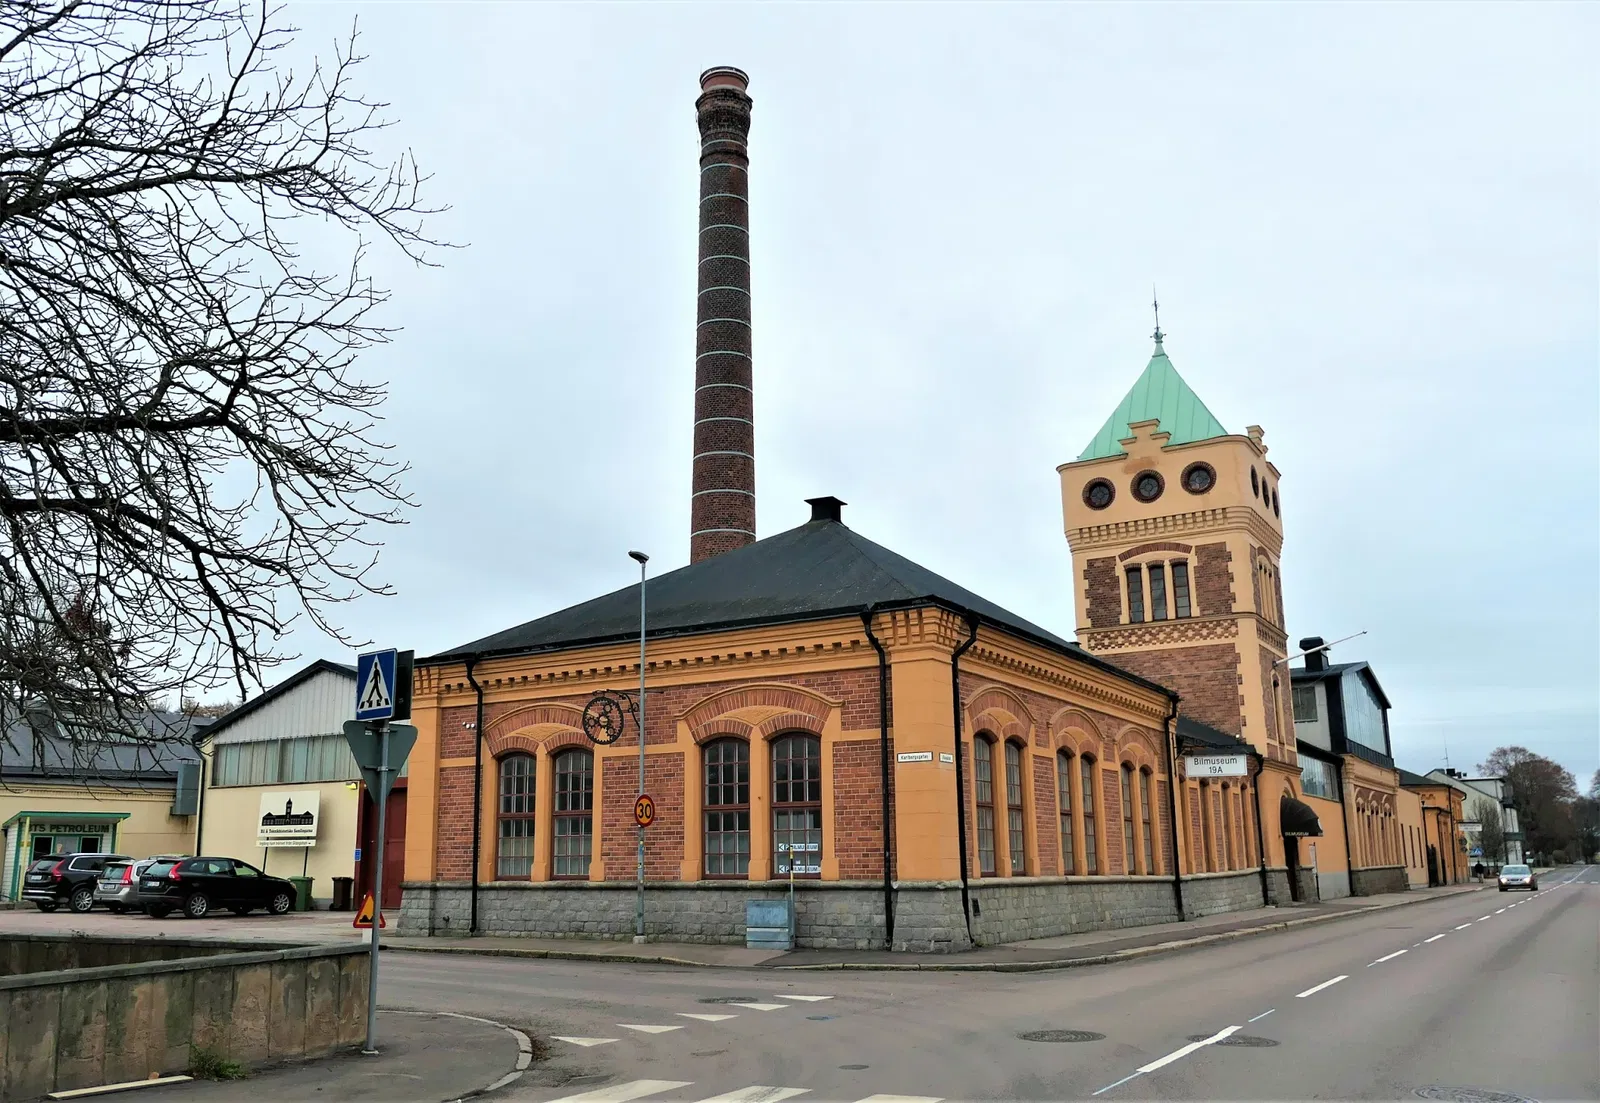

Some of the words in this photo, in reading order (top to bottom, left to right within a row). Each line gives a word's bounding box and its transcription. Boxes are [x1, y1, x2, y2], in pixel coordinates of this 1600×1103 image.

[1193, 757, 1238, 766] Bilmuseum
[1209, 766, 1223, 774] 19A
[638, 802, 652, 819] 30
[50, 824, 109, 832] PETROLEUM
